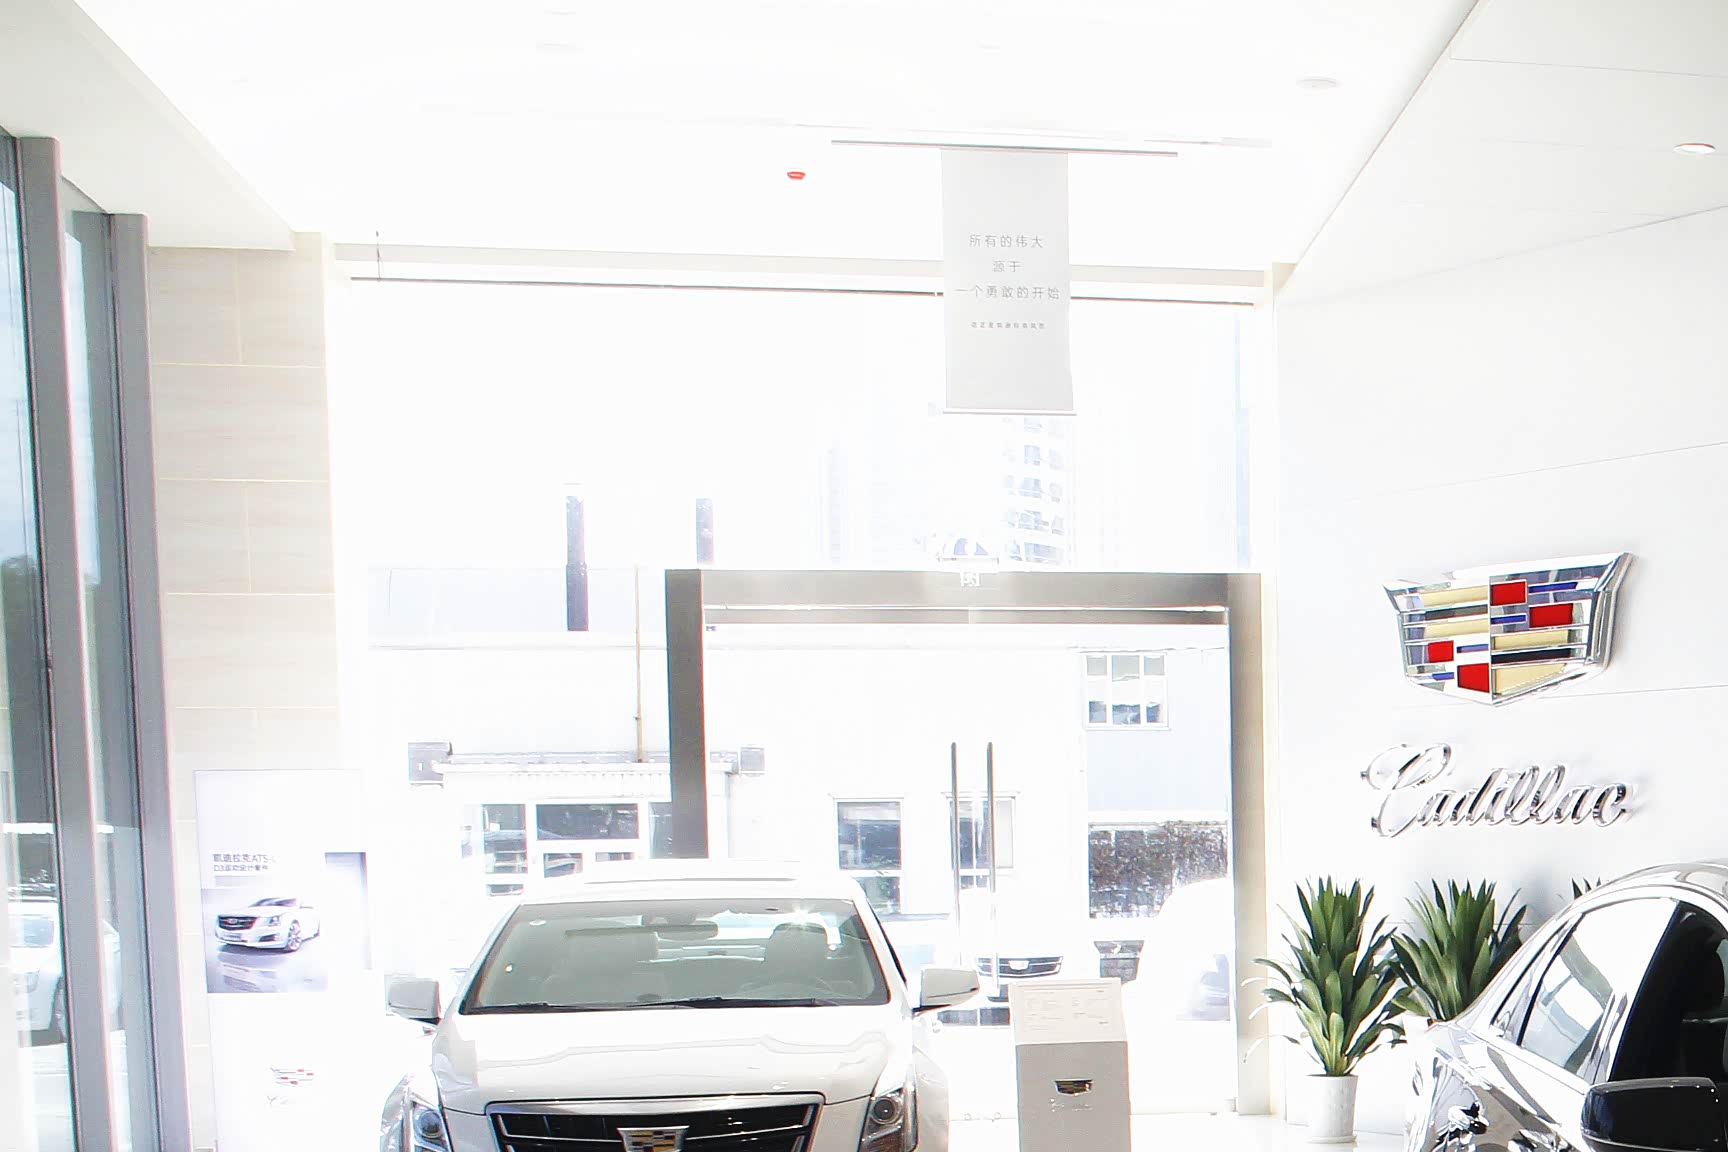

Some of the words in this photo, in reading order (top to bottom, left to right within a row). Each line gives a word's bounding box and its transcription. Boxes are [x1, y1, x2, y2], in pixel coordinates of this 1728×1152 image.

[969, 233, 1044, 248] 所有的伟大
[992, 260, 1022, 273] 源于
[954, 284, 1061, 300] 一个勇敢的开始
[1360, 742, 1632, 838] Cadillac
